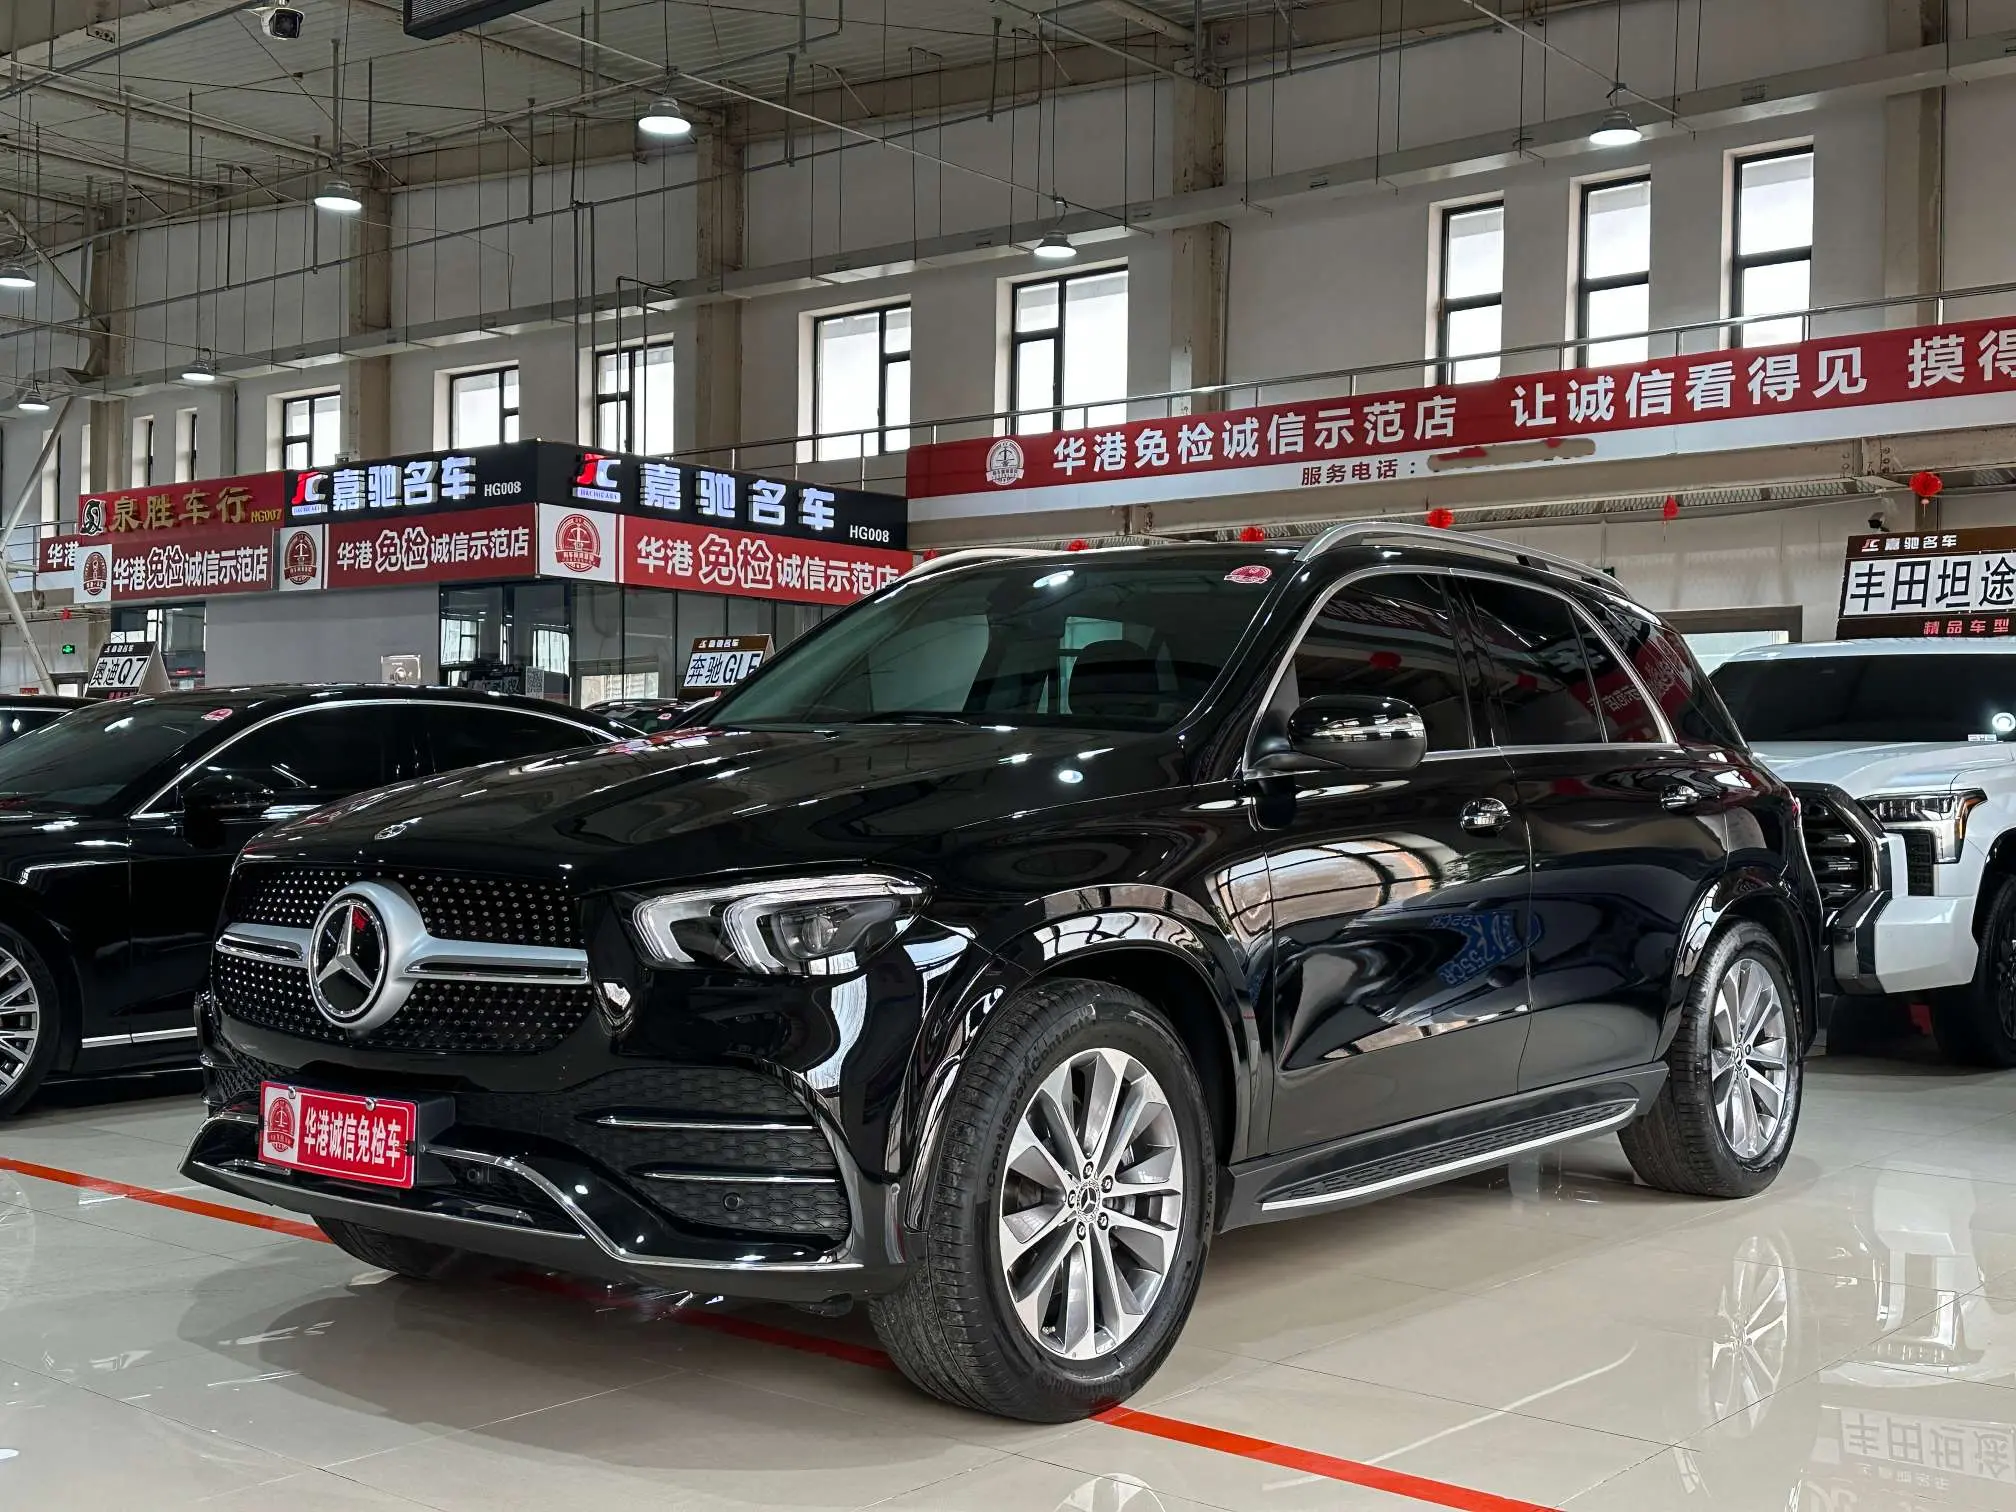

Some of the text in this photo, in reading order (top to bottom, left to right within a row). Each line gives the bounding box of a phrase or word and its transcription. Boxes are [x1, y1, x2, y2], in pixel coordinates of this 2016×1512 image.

[1511, 346, 1868, 428] 让诚信看得见
[1053, 396, 1457, 476] 华港免检诚信示范店
[110, 487, 254, 533] 泉胜车行
[333, 456, 522, 511] 嘉驰名车 HG008
[640, 463, 890, 543] 嘉驰名车 HG008
[113, 544, 268, 593] 华港免检诚信示范店
[337, 526, 530, 572] 华港免检诚信示范店
[1885, 534, 1957, 551] 嘉驰名车
[1850, 556, 2016, 612] 丰田坦途
[1923, 618, 2009, 636] 精品车型
[303, 1106, 402, 1168] 华港诚信免检车
